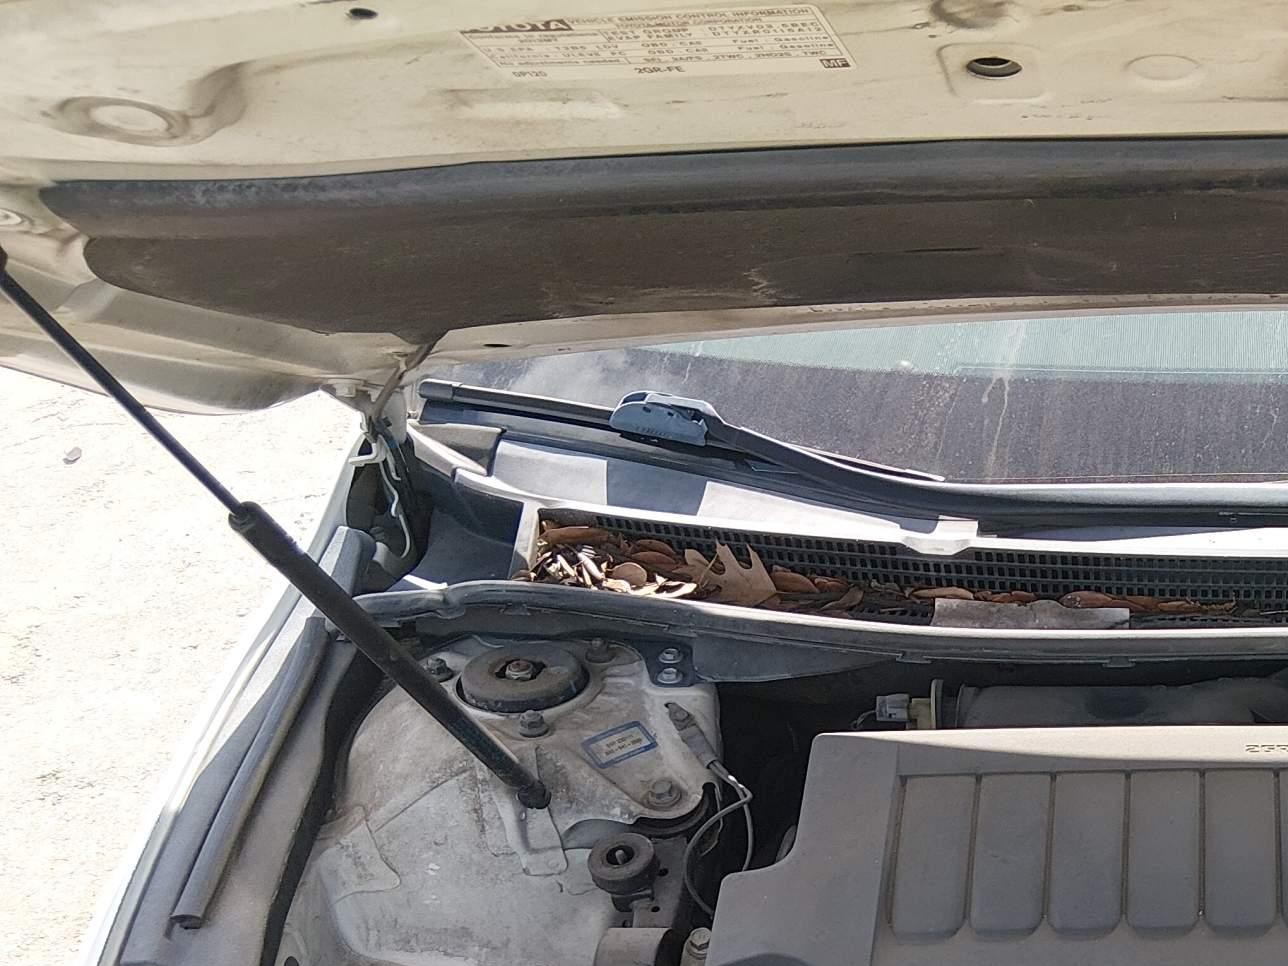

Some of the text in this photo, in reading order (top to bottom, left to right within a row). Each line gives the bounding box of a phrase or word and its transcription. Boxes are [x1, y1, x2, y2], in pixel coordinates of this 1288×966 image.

[732, 8, 809, 17] INFORMATION
[646, 32, 693, 40] FAMILY
[634, 65, 687, 74] 2GR-FE
